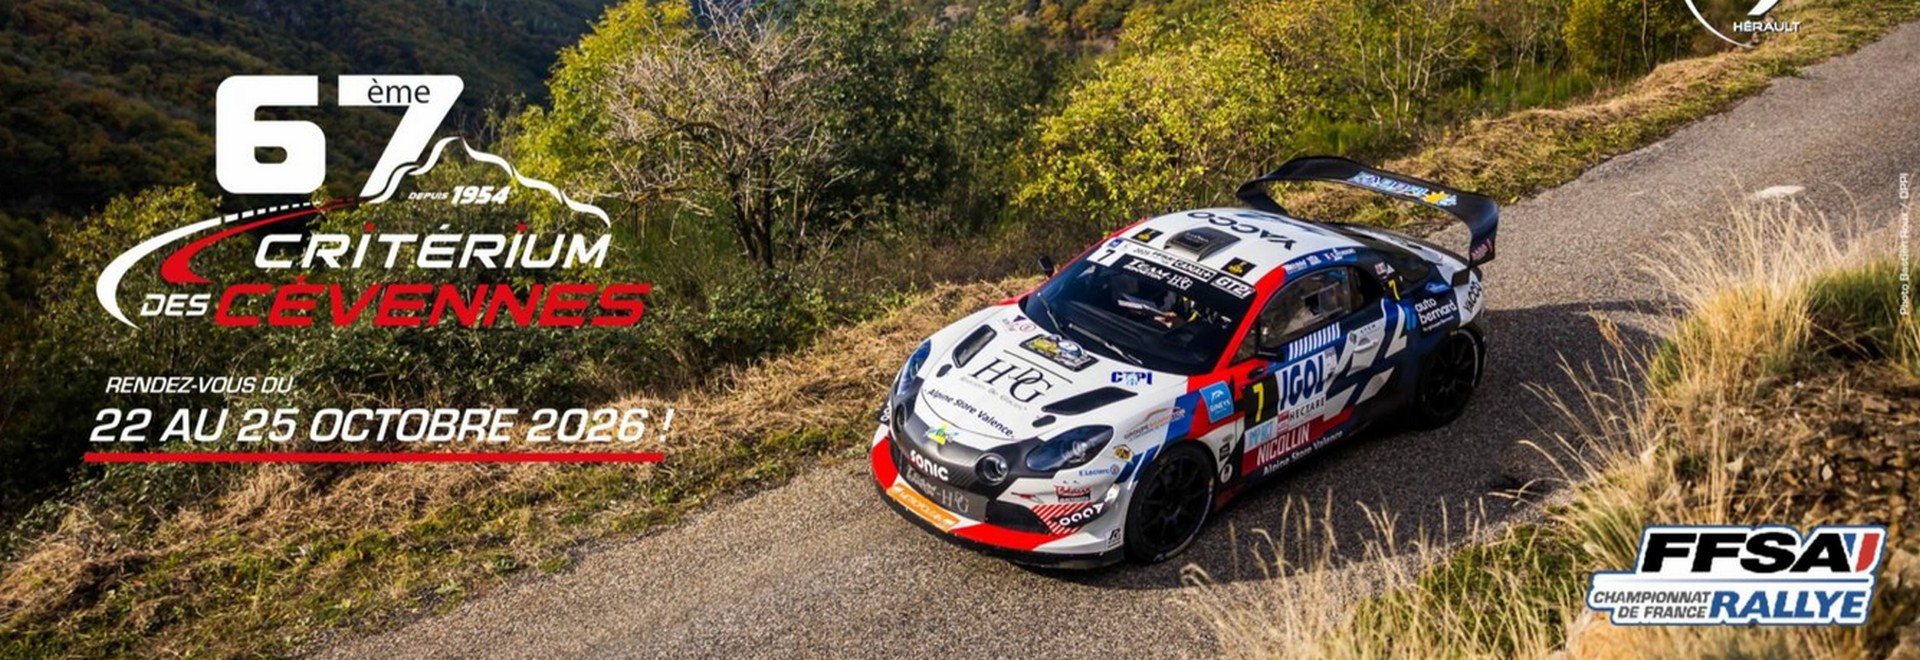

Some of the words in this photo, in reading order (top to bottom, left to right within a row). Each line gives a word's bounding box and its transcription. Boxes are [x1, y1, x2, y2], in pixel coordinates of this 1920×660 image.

[1187, 212, 1297, 250] YACCO
[1097, 249, 1116, 262] 7
[1388, 279, 1400, 300] 7
[1415, 298, 1437, 313] auto
[1418, 299, 1457, 325] bernard
[968, 356, 1054, 404] HPG
[928, 389, 954, 405] Alpine
[953, 399, 977, 415] Store
[1252, 382, 1265, 423] 7
[1256, 423, 1310, 467] NICOLLIN
